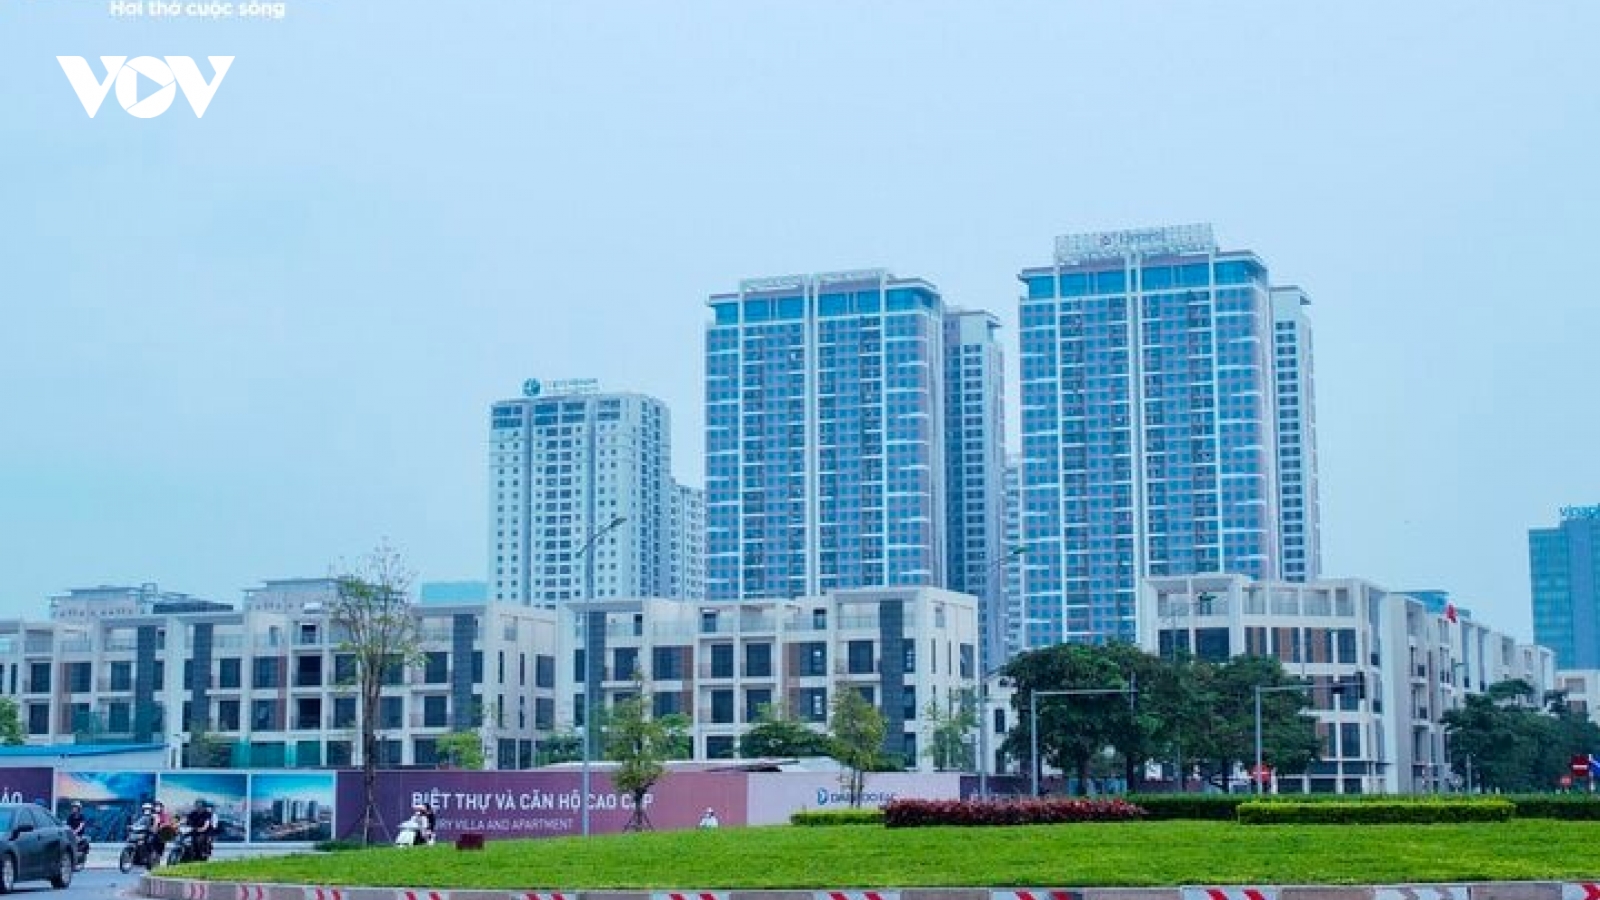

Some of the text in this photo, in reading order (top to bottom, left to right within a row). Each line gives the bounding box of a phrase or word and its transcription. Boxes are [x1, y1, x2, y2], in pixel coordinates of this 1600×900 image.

[455, 792, 492, 814] THỰ
[494, 789, 516, 810] VÀ
[519, 789, 554, 810] CĂN
[558, 789, 581, 814] HỘ
[588, 792, 617, 810] CAO
[621, 790, 654, 810] CP
[454, 818, 484, 830] VILLA
[486, 818, 510, 830] AND
[512, 818, 573, 830] APARTMENT
